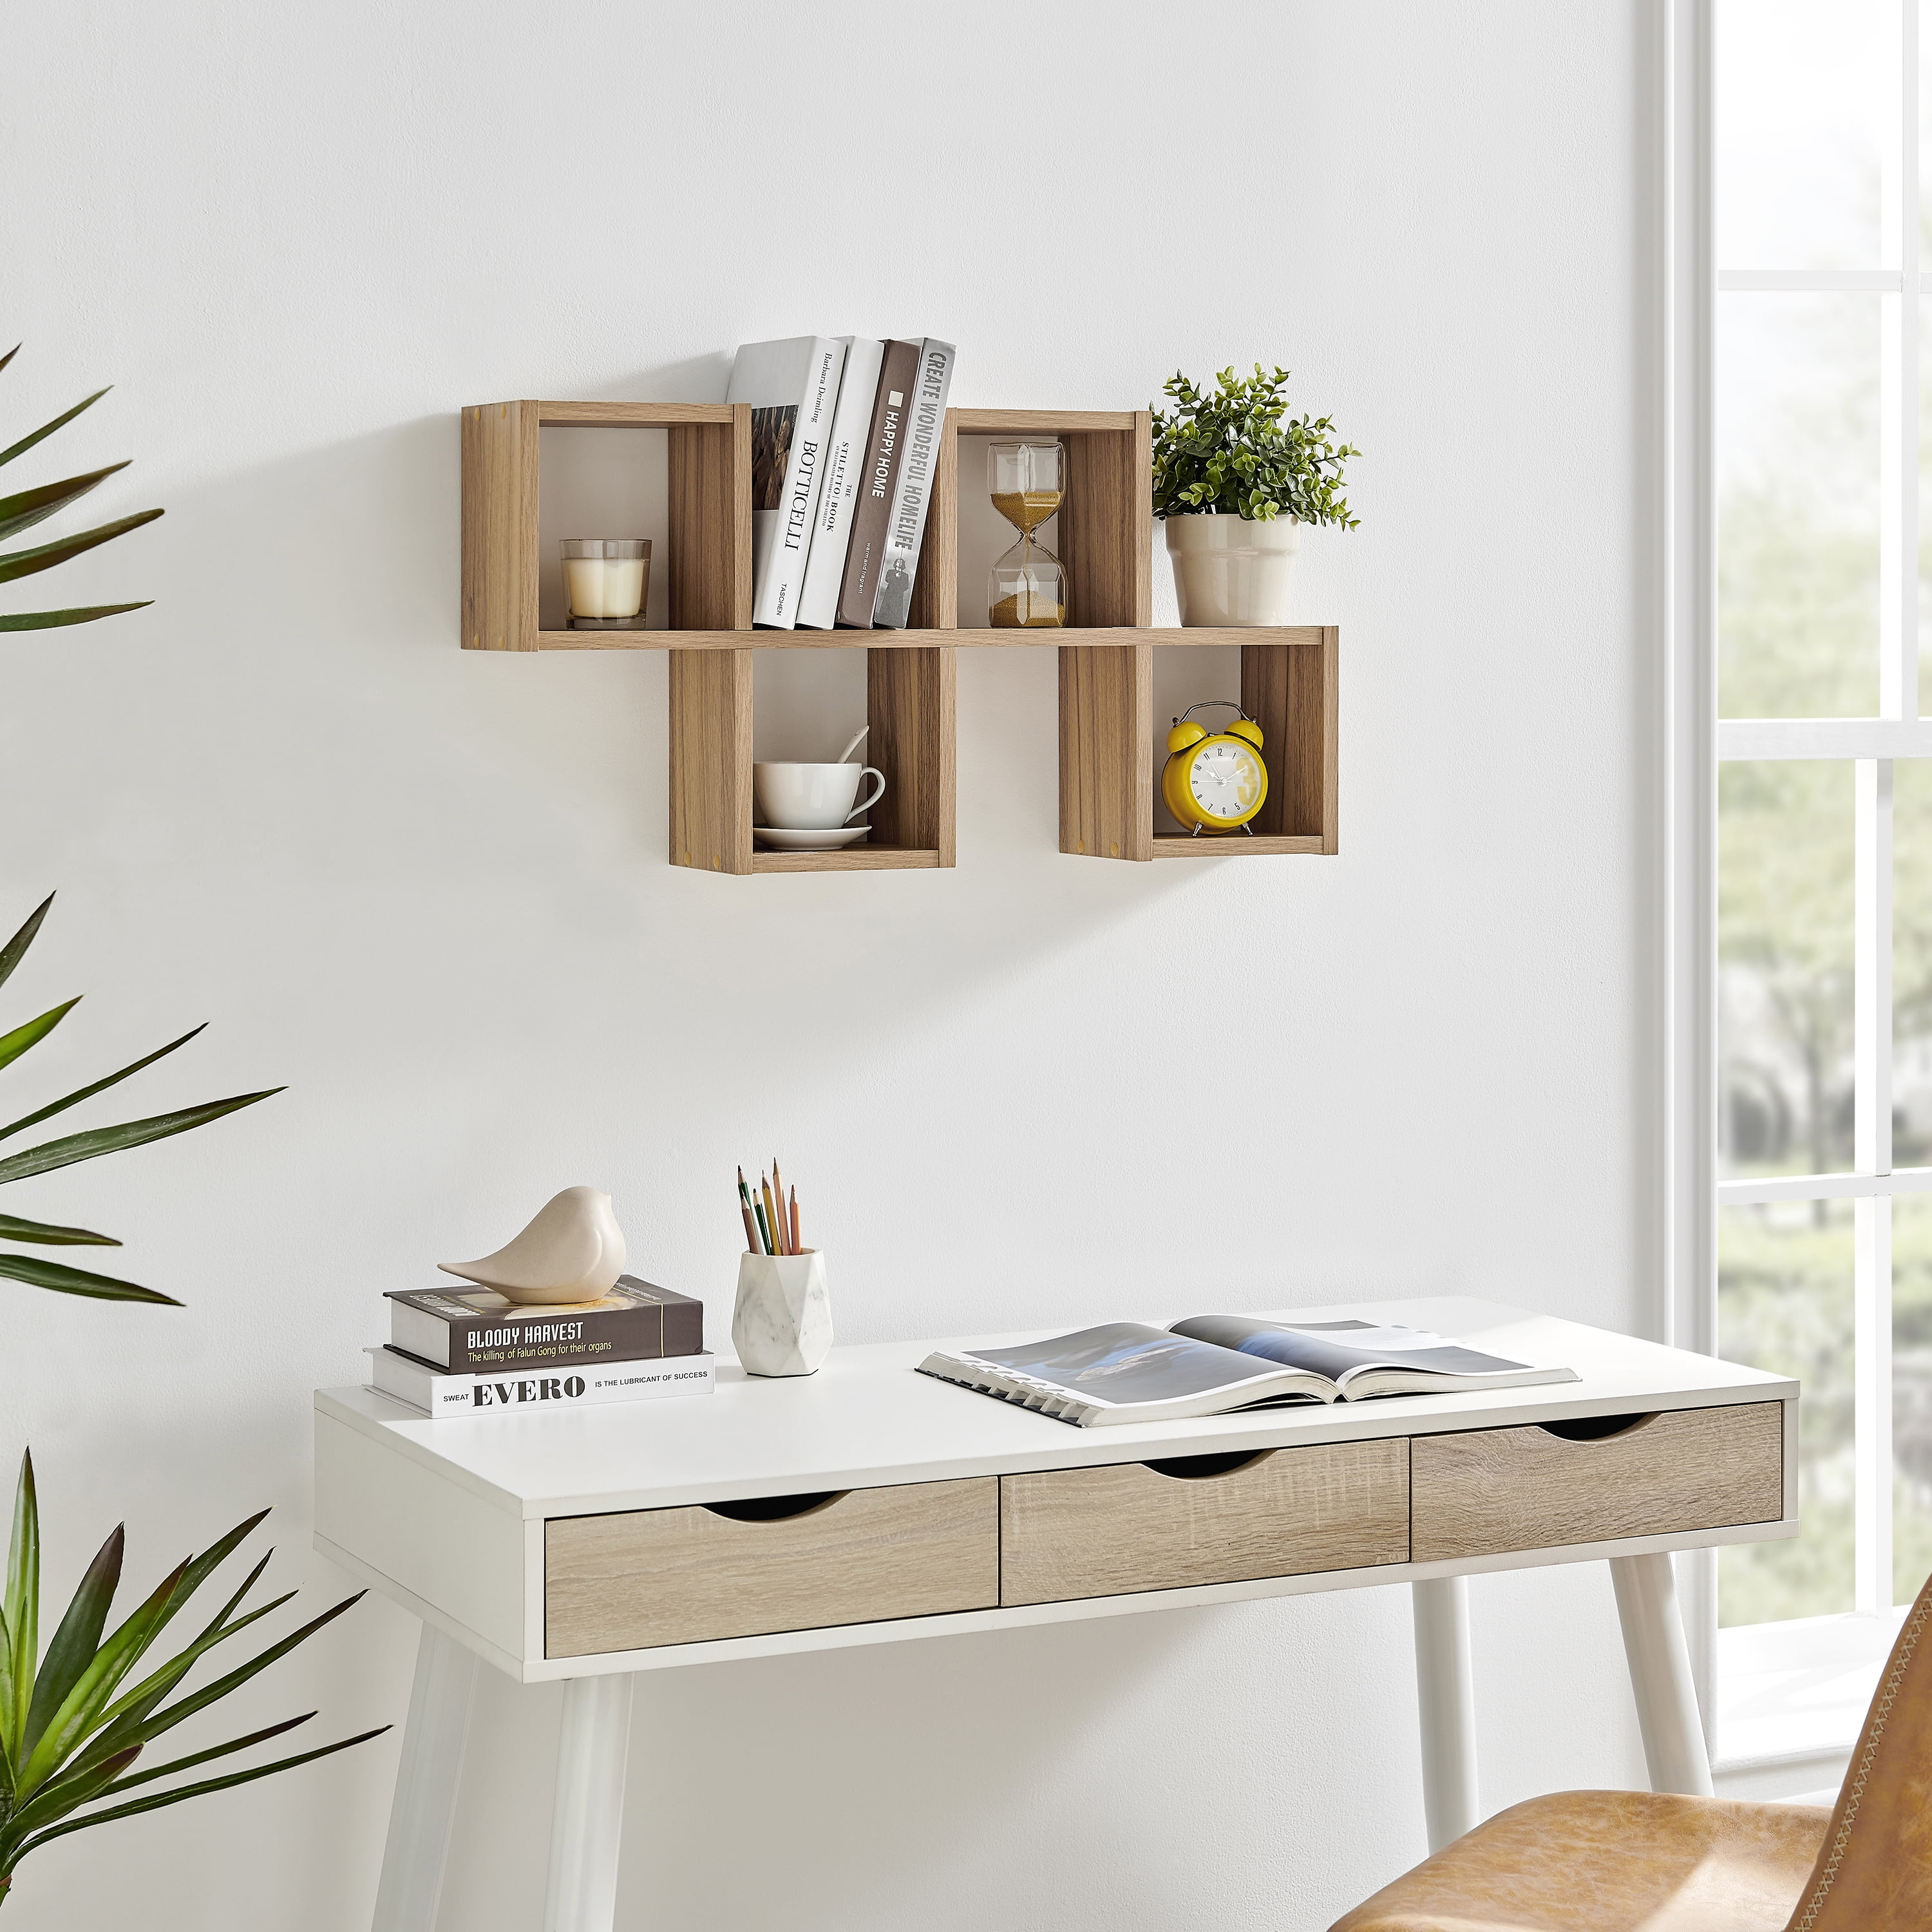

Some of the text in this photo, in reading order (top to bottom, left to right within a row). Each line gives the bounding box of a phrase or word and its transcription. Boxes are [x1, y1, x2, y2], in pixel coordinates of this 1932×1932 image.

[810, 352, 833, 424] Barbara Deimling
[871, 410, 900, 499] HAPPY HOME
[895, 352, 947, 551] CREATE WONDERFUL HOMELIFE
[784, 440, 819, 551] BOTTICELLI
[826, 441, 849, 532] STILETTO BOOK
[844, 484, 853, 498] THE
[858, 571, 867, 594] fragrant
[776, 583, 787, 616] TASCHEN
[1203, 752, 1211, 761] 11
[1217, 748, 1223, 757] 12
[1236, 757, 1257, 806] 3
[1222, 807, 1226, 815] 6
[468, 1321, 583, 1349] BLOODY HARVEST
[468, 1341, 612, 1363] The killing of Falun Gong for their organs
[443, 1394, 469, 1402] SWEAT
[471, 1376, 585, 1407] EVERO
[620, 1376, 661, 1385] LUBRICANT
[674, 1370, 708, 1379] SUCCESS
